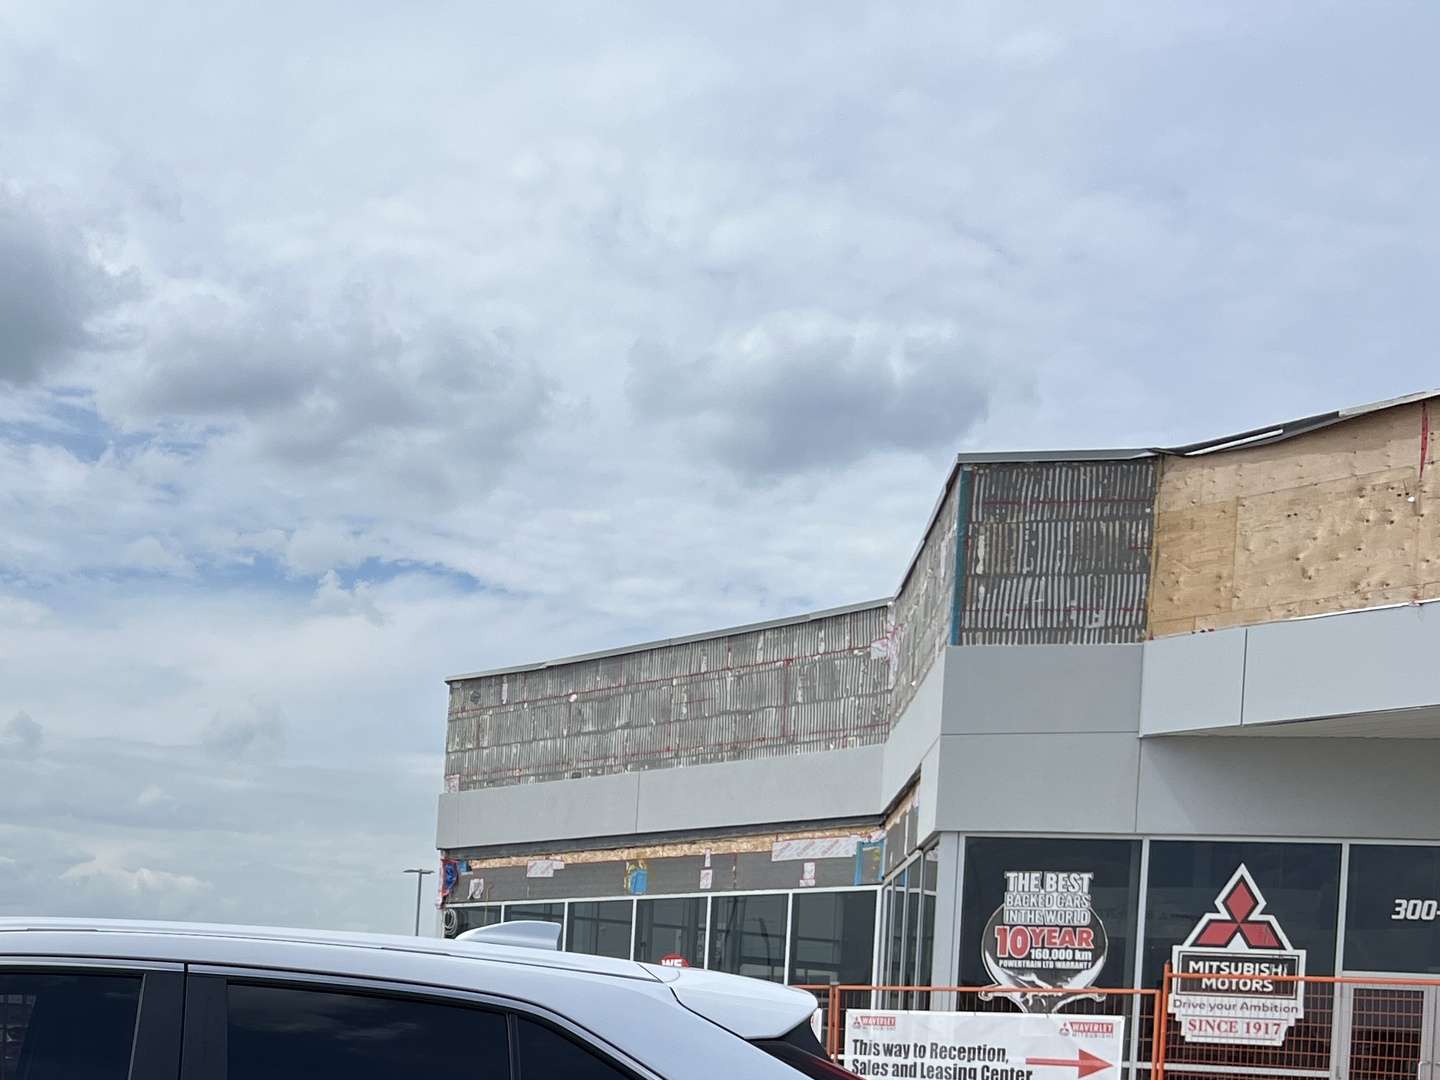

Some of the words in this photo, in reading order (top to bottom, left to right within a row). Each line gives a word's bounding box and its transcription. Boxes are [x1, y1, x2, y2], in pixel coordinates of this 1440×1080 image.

[1005, 872, 1041, 892] THE
[1045, 872, 1093, 893] BEST
[1006, 894, 1054, 908] BACKED
[1057, 894, 1091, 909] CARS
[1045, 909, 1089, 924] WORLD
[995, 926, 1030, 958] 10
[1028, 927, 1094, 948] YEAR
[1075, 949, 1092, 960] km
[1189, 961, 1288, 977] MITSUBISHI
[1201, 978, 1273, 992] MOTORS
[1173, 999, 1205, 1010] Drive
[1208, 1001, 1237, 1015] your
[1240, 1001, 1298, 1014] Ambition
[1188, 1019, 1238, 1033] SINCE
[1245, 1022, 1281, 1035] 1917
[852, 1039, 880, 1057] This
[882, 1043, 911, 1060] way
[913, 1042, 926, 1059] to
[930, 1042, 1009, 1065] Reception,
[851, 1059, 889, 1077] Sales
[892, 1061, 917, 1078] and
